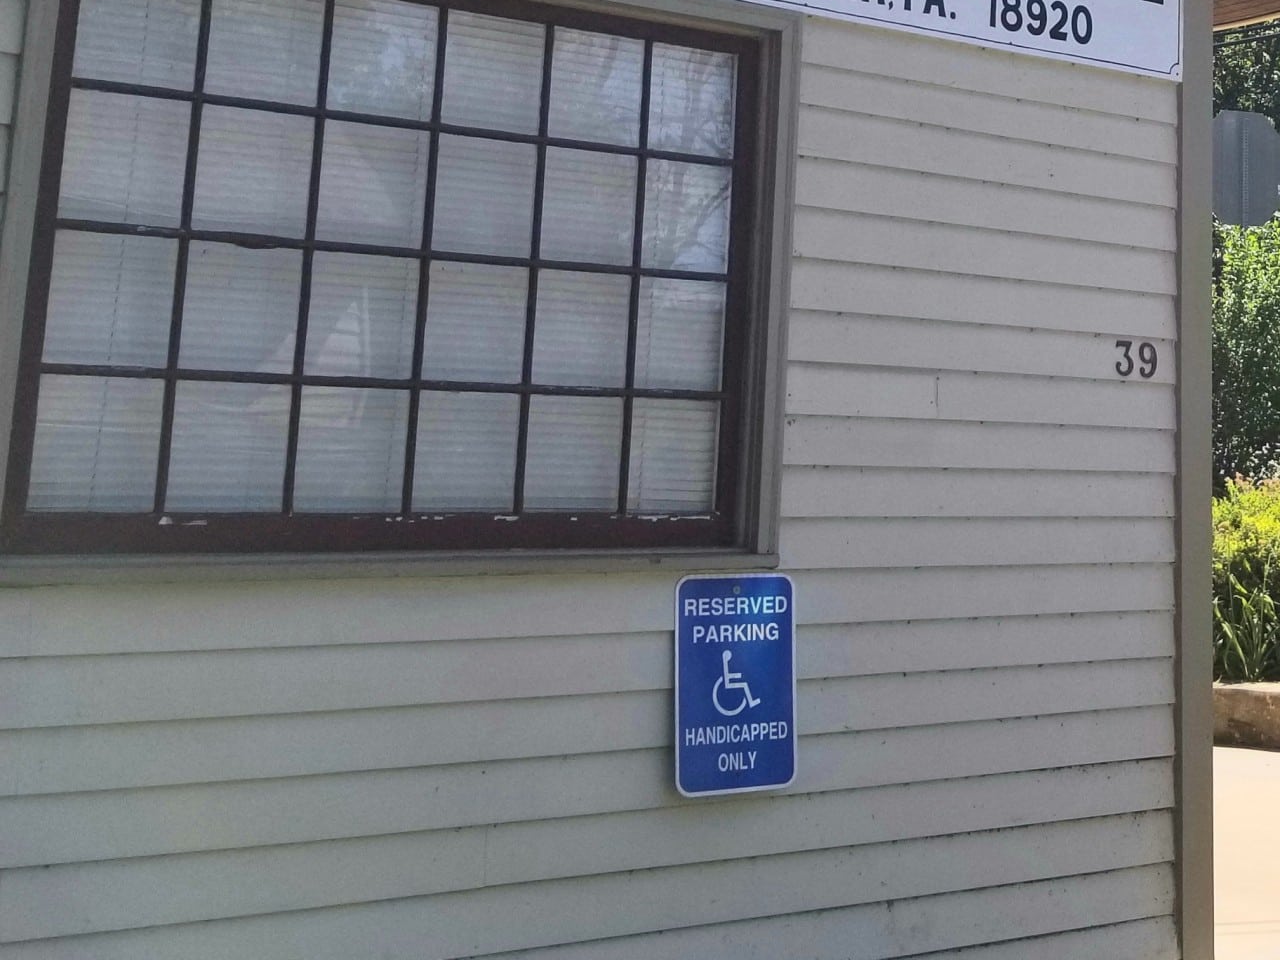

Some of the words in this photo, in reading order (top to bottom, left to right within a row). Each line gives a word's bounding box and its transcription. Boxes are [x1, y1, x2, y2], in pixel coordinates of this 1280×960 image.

[1115, 340, 1158, 378] 39
[684, 596, 788, 617] RESERVED
[693, 622, 779, 644] PARKING
[685, 721, 788, 746] HANDICAPPED
[718, 751, 757, 772] ONLY
